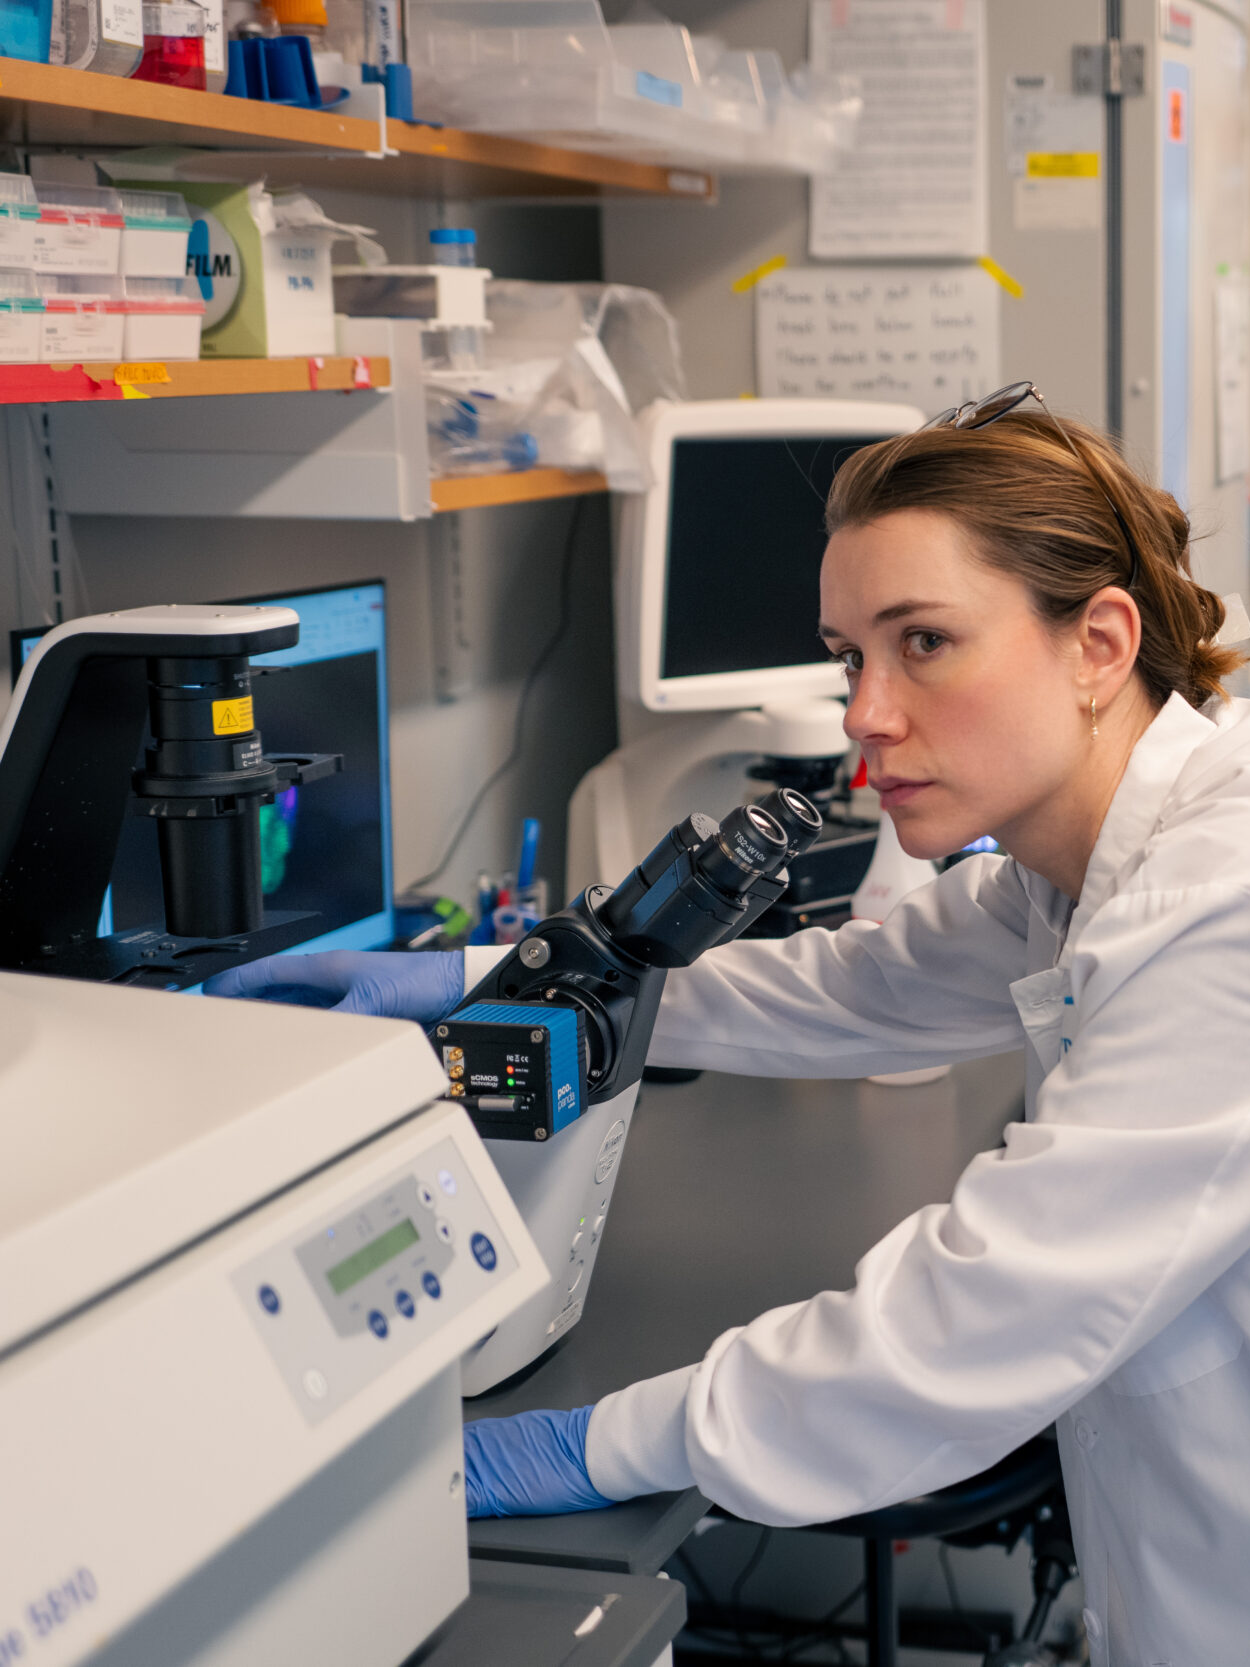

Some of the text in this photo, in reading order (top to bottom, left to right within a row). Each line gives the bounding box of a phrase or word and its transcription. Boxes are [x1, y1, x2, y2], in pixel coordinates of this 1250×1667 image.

[734, 831, 766, 862] TS2-W10x
[734, 846, 754, 864] Nikon
[470, 1074, 499, 1082] sCMOS
[557, 1091, 576, 1113] panda
